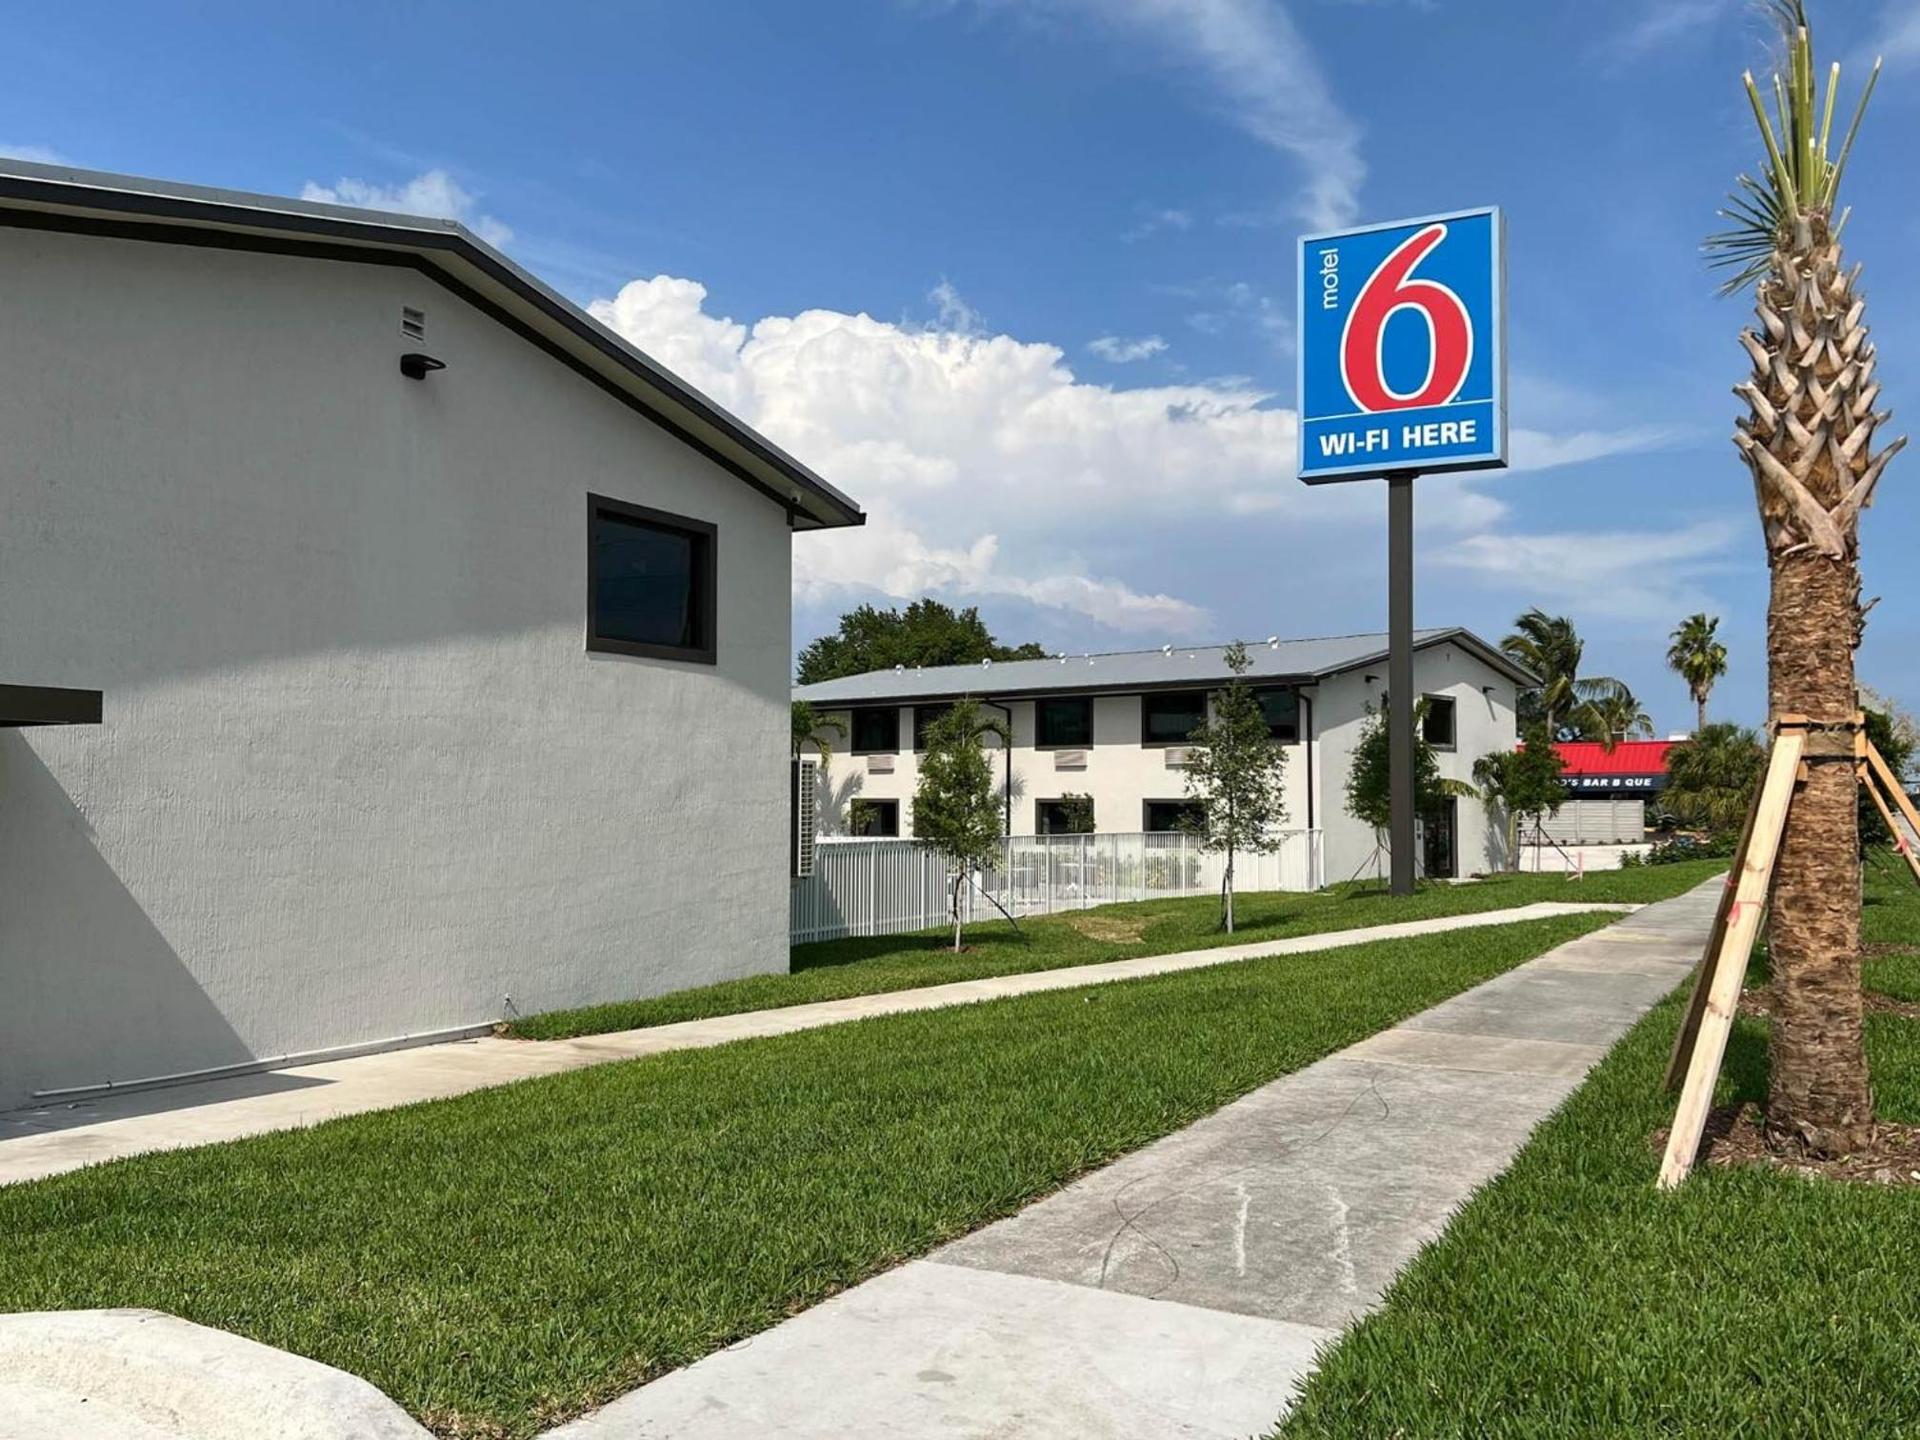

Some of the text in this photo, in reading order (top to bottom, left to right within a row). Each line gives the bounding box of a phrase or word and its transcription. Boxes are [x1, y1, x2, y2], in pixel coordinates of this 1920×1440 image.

[1319, 248, 1339, 310] motel
[1339, 222, 1474, 414] 6
[1319, 419, 1477, 457] WI-FI HERE
[1582, 777, 1609, 787] BAR
[1612, 777, 1621, 787] B
[1624, 777, 1653, 788] QUE
